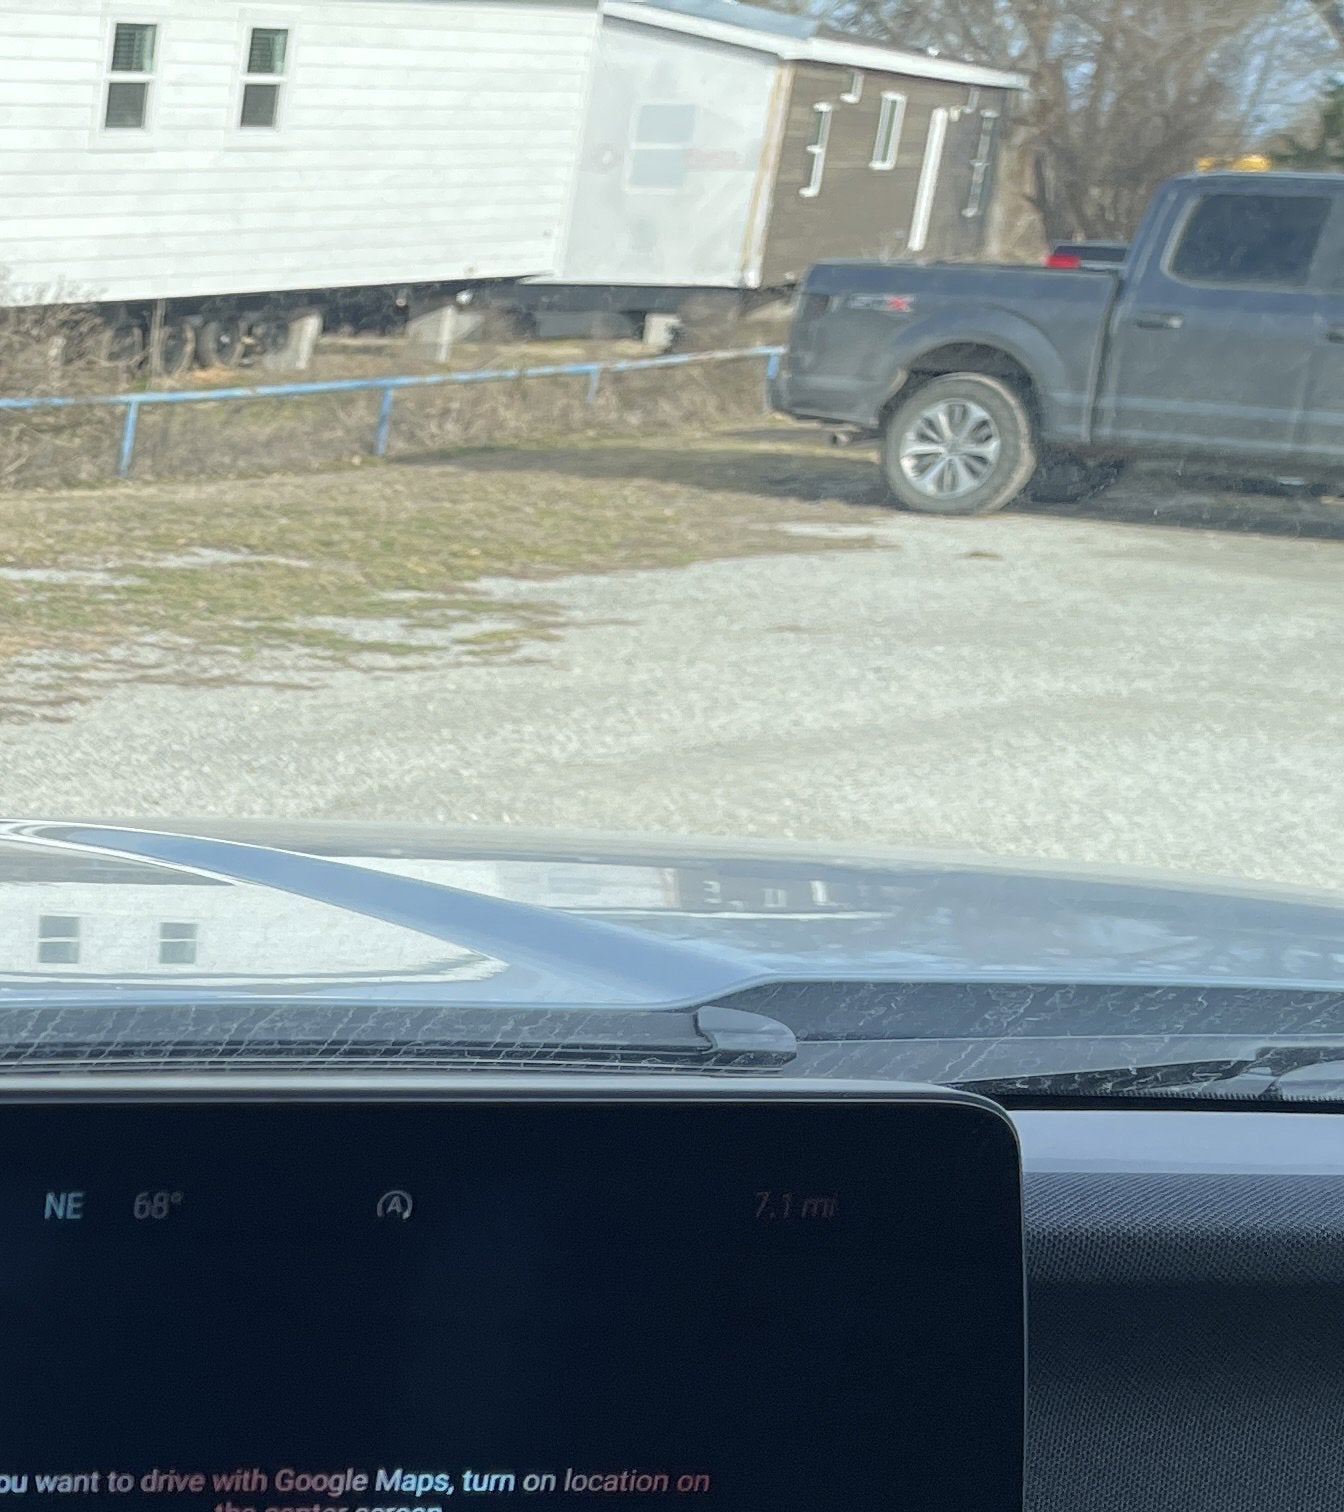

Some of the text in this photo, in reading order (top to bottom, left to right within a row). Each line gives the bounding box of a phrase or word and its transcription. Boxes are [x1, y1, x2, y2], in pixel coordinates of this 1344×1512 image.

[44, 1191, 85, 1220] NE
[756, 1191, 839, 1219] 7.1 mi
[35, 1470, 100, 1494] want
[107, 1471, 134, 1493] to
[140, 1468, 207, 1493] drive
[212, 1468, 268, 1493] with
[274, 1467, 368, 1498] Google
[374, 1468, 455, 1498] Maps,
[462, 1469, 514, 1493] turn
[522, 1474, 556, 1493] on
[563, 1467, 669, 1493] location
[676, 1473, 710, 1493] on
